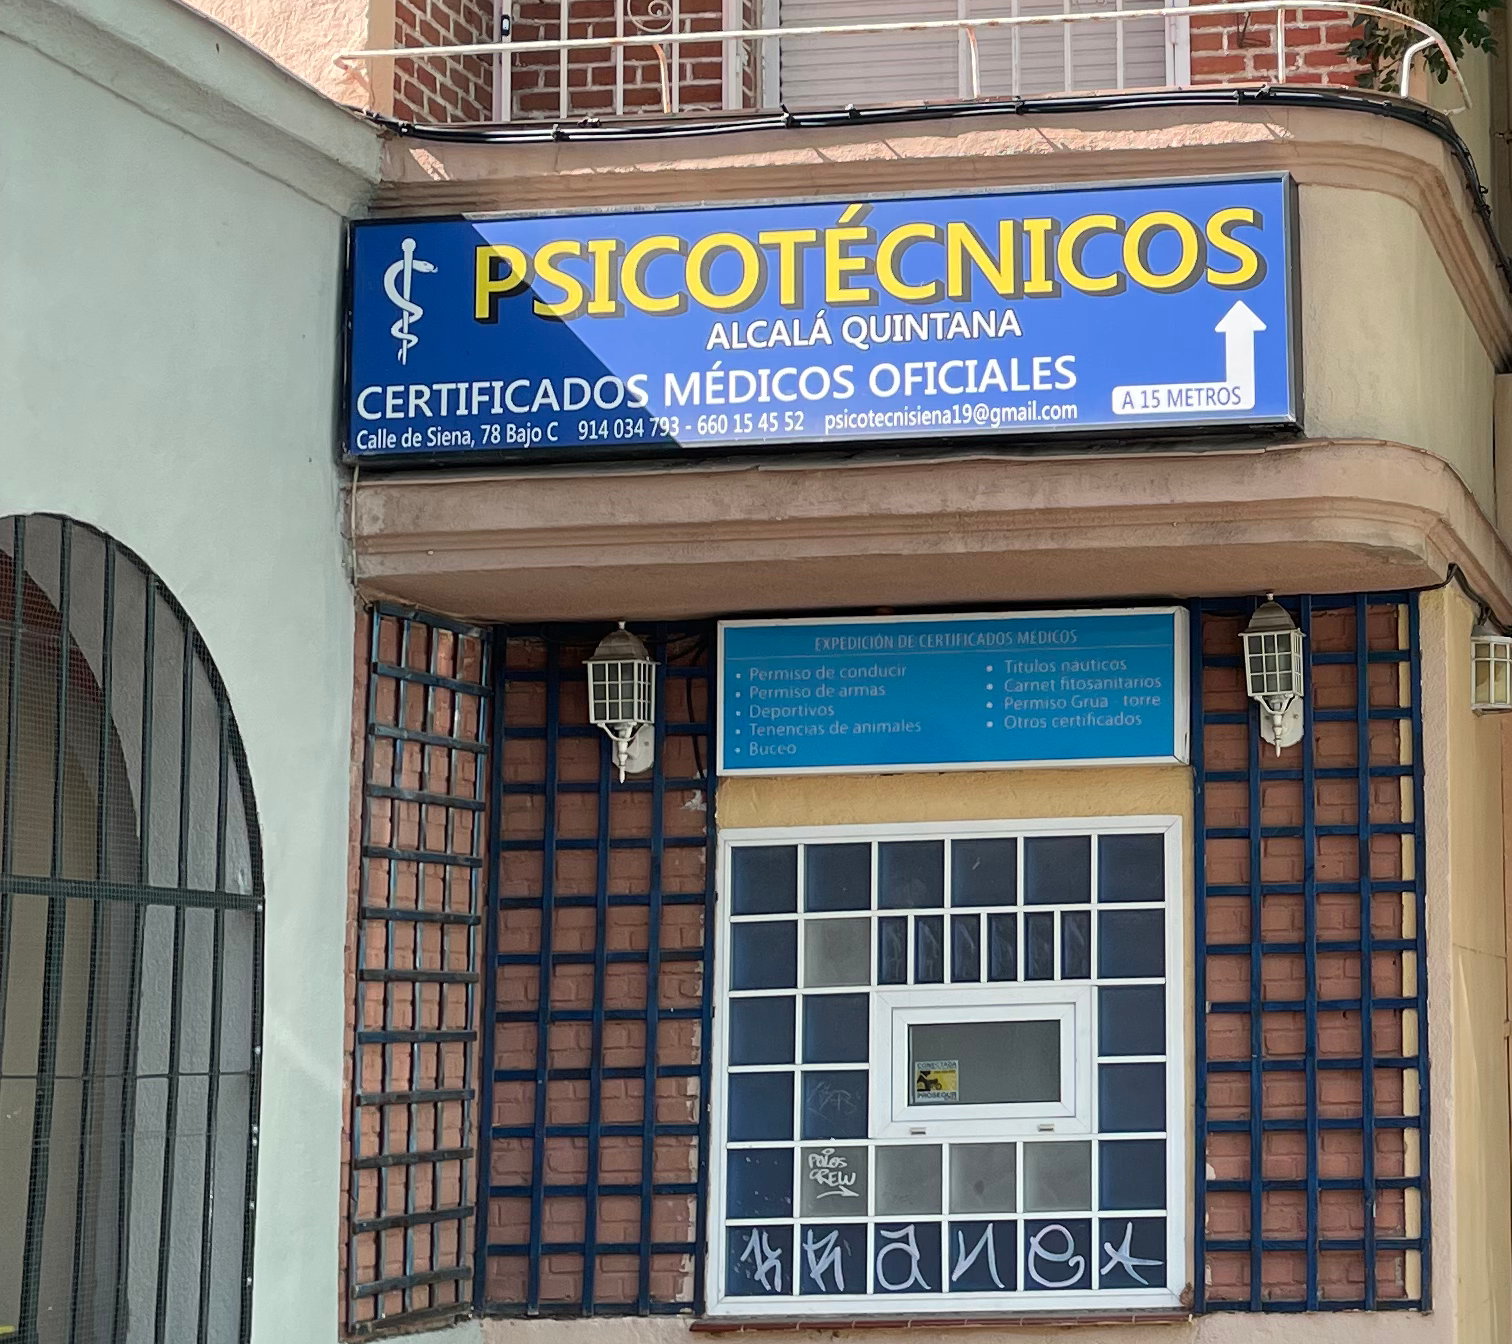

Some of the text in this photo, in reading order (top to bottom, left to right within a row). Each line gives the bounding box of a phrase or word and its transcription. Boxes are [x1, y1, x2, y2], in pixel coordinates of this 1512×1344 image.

[475, 203, 1264, 321] PSICOTÉCNICOS
[706, 309, 1022, 350] ALCALÁ QUINTANA
[357, 355, 1077, 420] CERTIFICADOS MÉDICOS OFICIALES
[1121, 386, 1241, 409] A 15 METROS
[356, 429, 396, 450] Calle
[401, 427, 427, 448] de
[427, 426, 475, 448] Siena,
[481, 425, 501, 445] 78
[506, 422, 542, 448] Bajo
[546, 422, 559, 441] C
[578, 420, 609, 440] 914
[613, 418, 644, 439] 034
[650, 416, 680, 437] 793
[697, 414, 728, 435] 660
[733, 413, 753, 433] 15
[758, 412, 779, 433] 45
[784, 411, 804, 431] 52
[825, 401, 1078, 434] psicotecnisiena19@gmail.com
[814, 632, 893, 651] EXPEDICIÓN
[898, 634, 914, 648] DE
[919, 630, 1013, 648] CERTIFICADOS
[750, 663, 906, 681] Permiso de conducir
[750, 683, 886, 700] Permiso de armas
[1004, 675, 1162, 693] Carnet fitosanitarios
[750, 704, 835, 720] Deportivos
[1004, 696, 1067, 710] Permiso
[750, 719, 921, 737] Tenencias de animales
[1004, 711, 1142, 729] Otros certificados
[750, 742, 797, 756] Buceo
